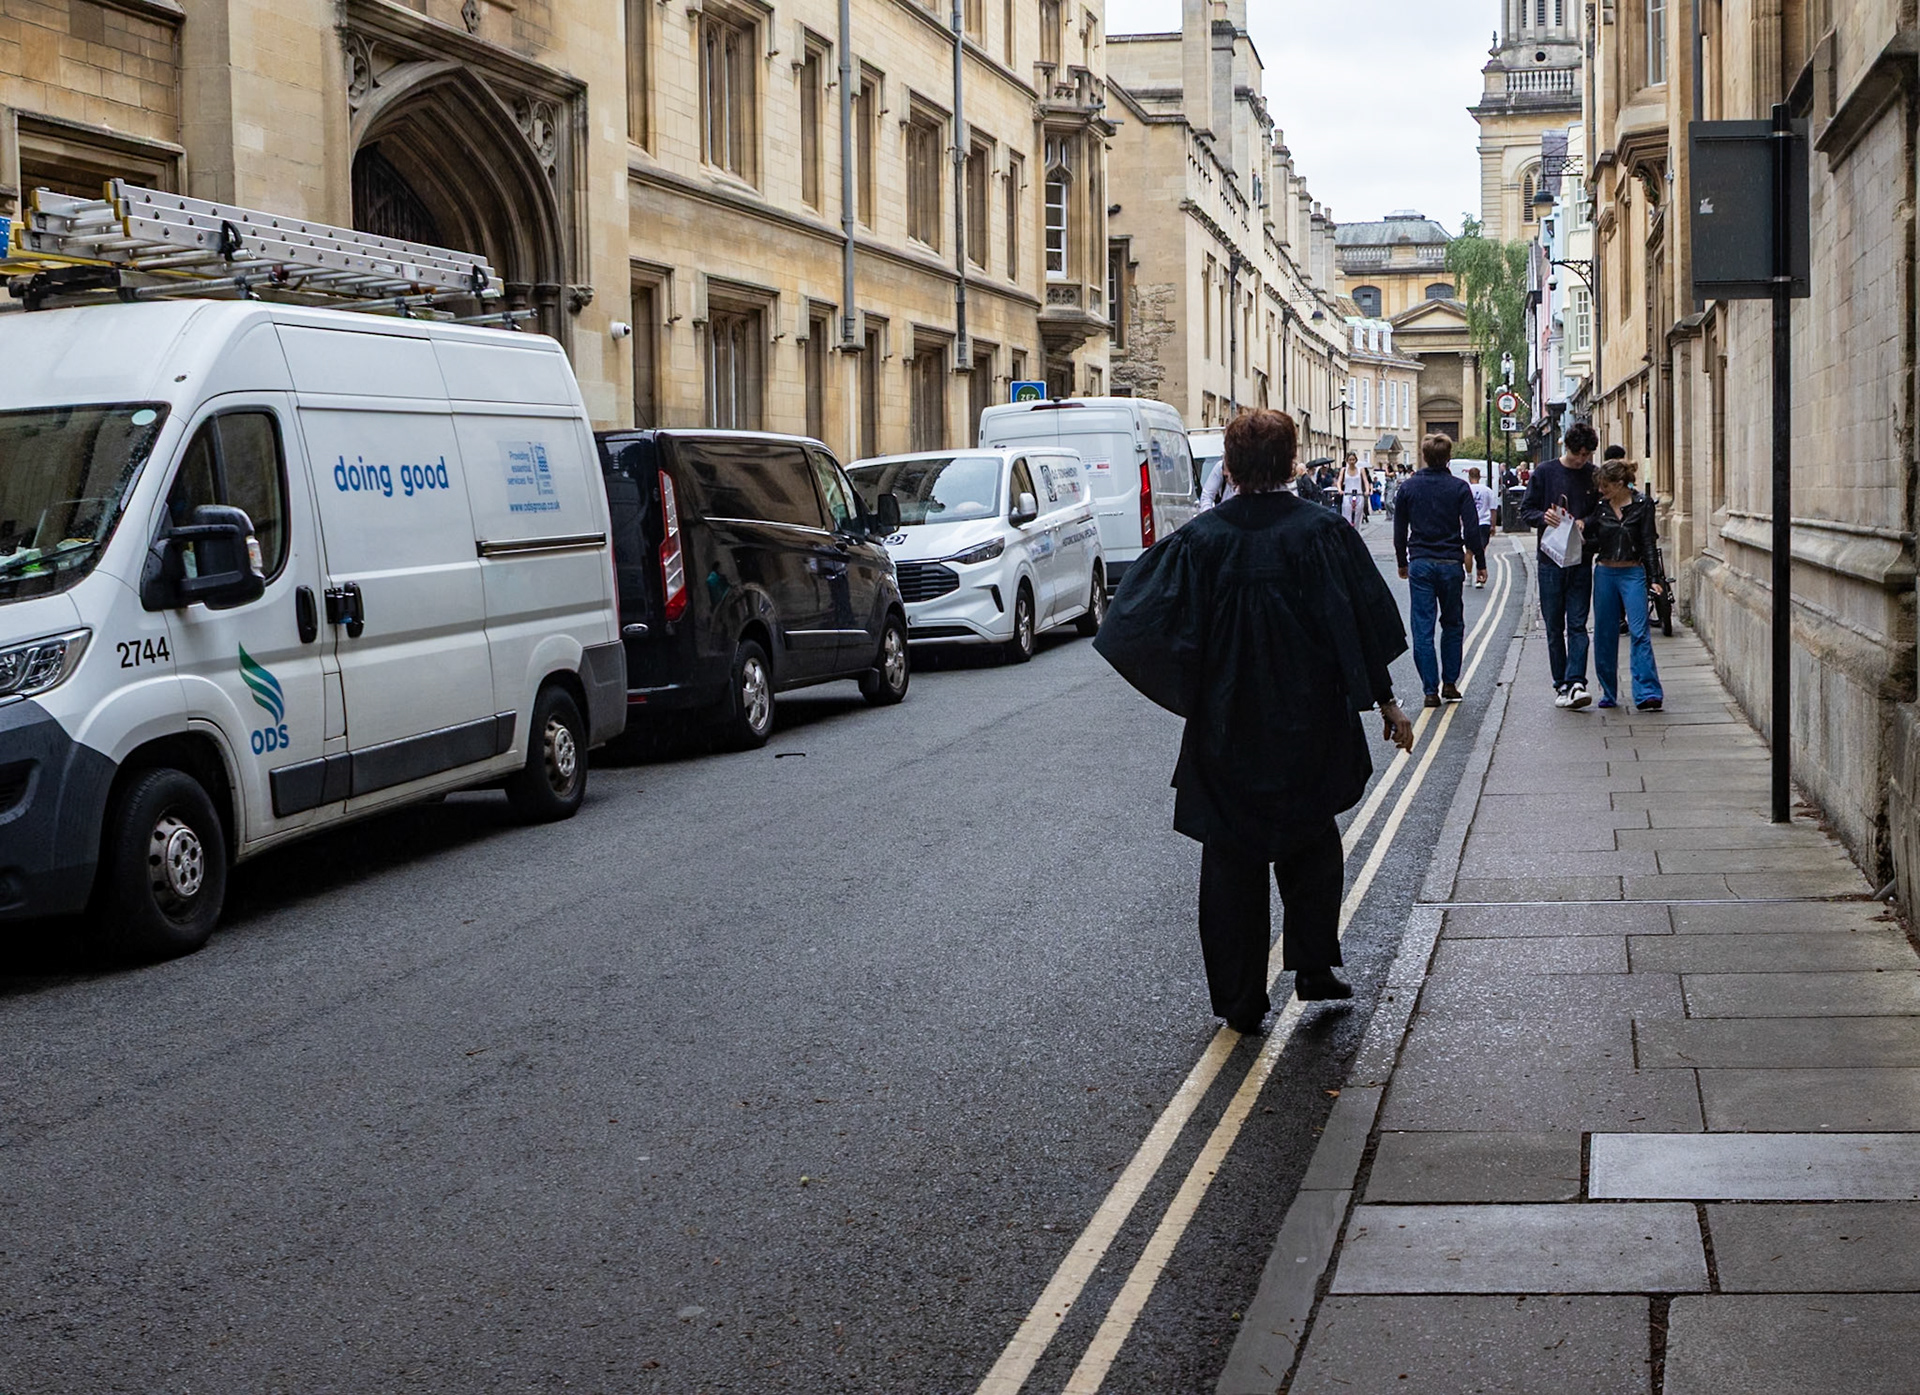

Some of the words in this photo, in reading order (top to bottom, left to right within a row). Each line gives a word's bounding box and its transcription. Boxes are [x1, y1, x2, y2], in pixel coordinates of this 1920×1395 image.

[1020, 393, 1036, 401] ZEZ
[333, 455, 393, 498] doing
[400, 455, 450, 497] good
[116, 636, 170, 669] 2744
[251, 724, 290, 756] ODS
